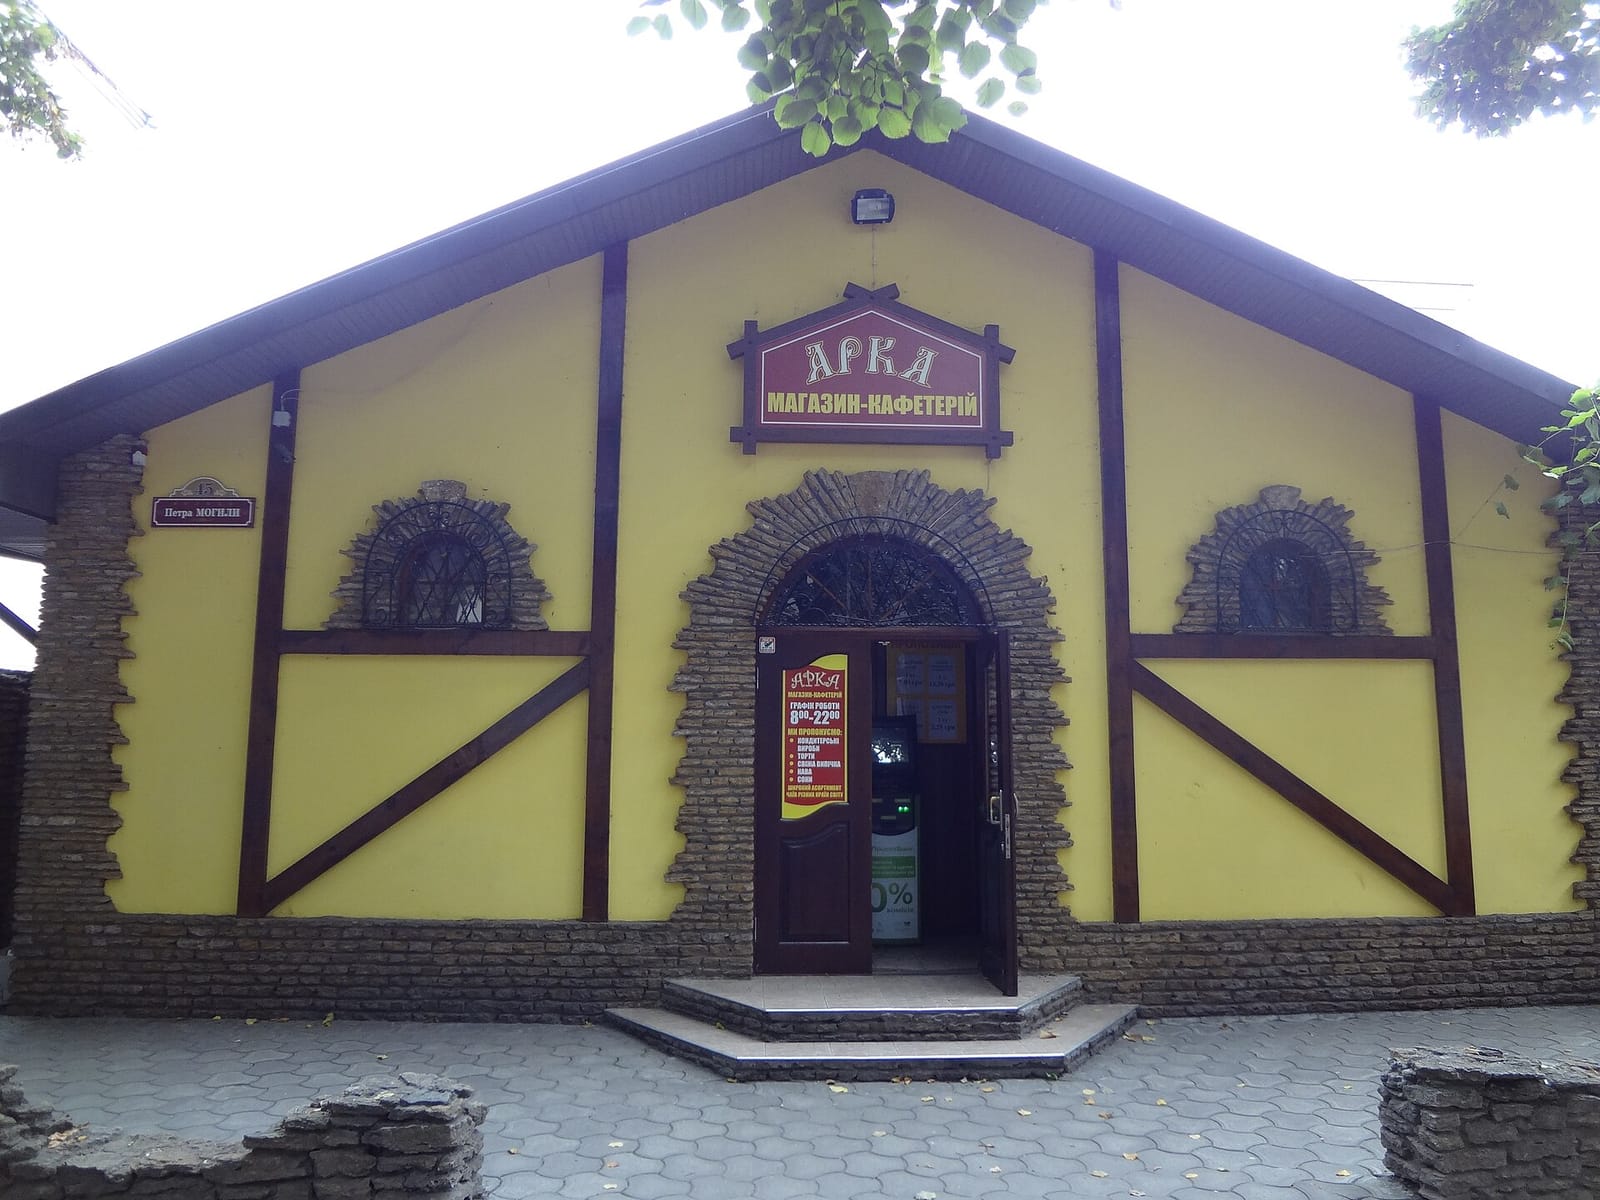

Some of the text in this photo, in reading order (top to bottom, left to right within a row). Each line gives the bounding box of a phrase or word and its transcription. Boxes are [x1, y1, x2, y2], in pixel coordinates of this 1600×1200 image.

[804, 335, 939, 388] АРКА
[767, 392, 978, 416] МАГАЗИН-КАФЕТЕРІЙ
[164, 508, 241, 518] Петра МОГИЛИ
[792, 670, 840, 689] АРКА
